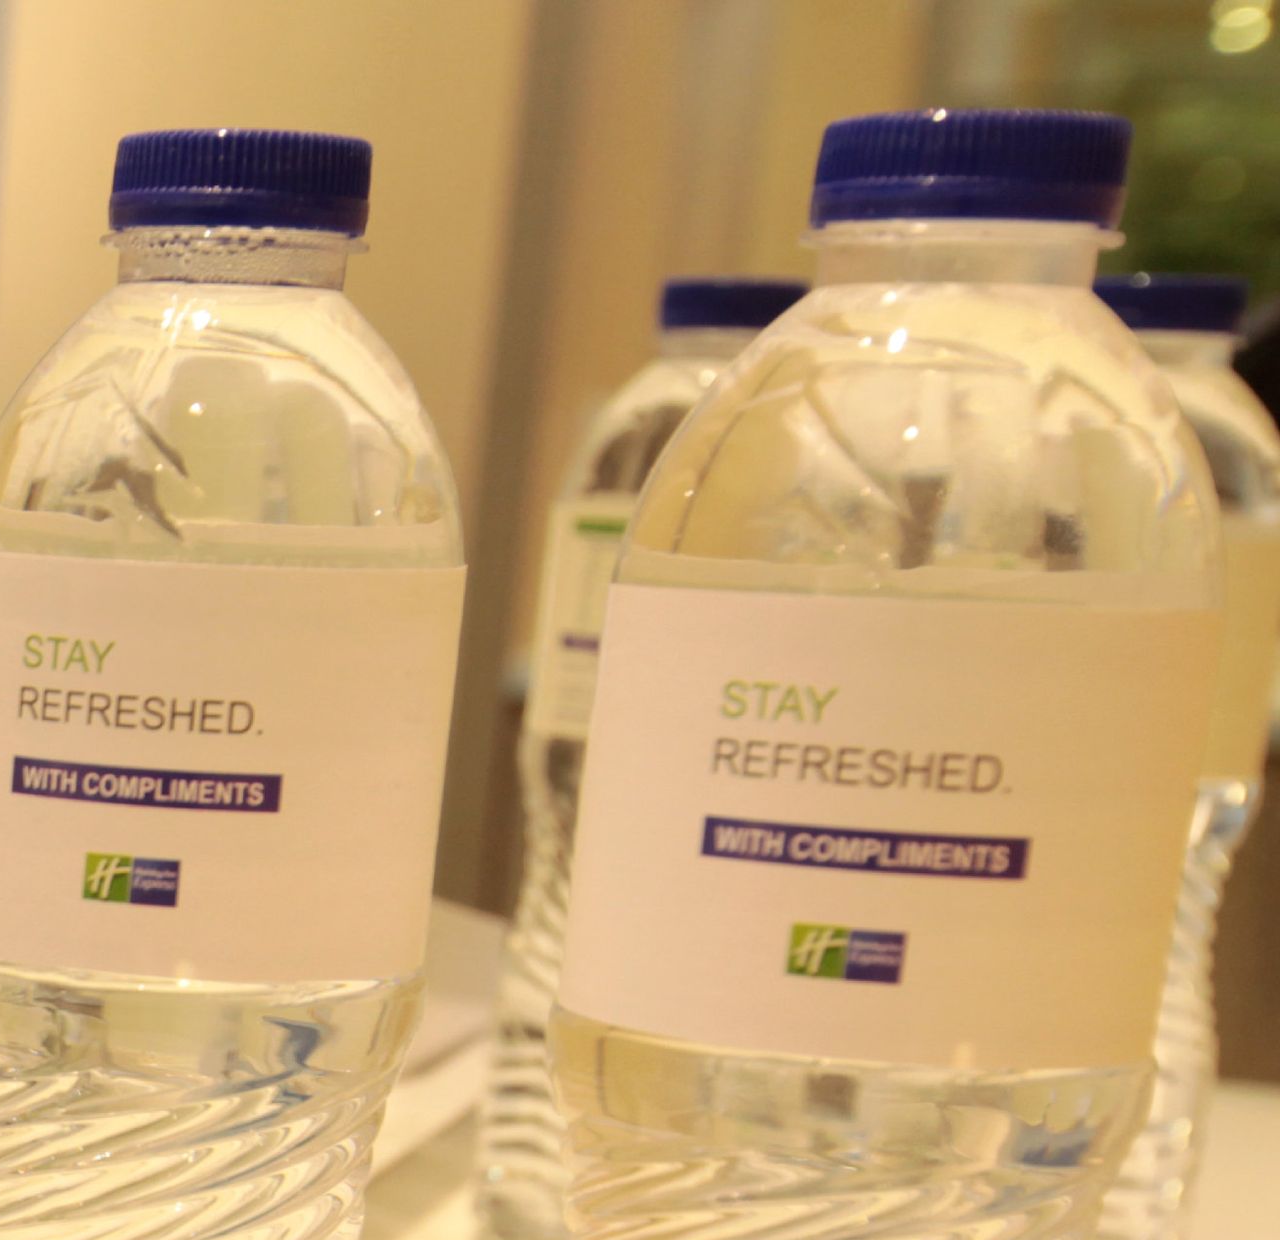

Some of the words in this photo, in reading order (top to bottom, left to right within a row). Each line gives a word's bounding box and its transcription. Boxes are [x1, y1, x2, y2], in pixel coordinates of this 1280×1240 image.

[22, 634, 115, 673] STAY
[18, 686, 263, 736] REFRESHED.
[720, 680, 838, 722] STAY
[22, 765, 77, 794] WITH
[82, 772, 265, 806] COMPLIMENTS
[711, 737, 1012, 794] REFRESHED.
[713, 825, 786, 857] WITH
[790, 833, 1010, 873] COMPLIMENTS
